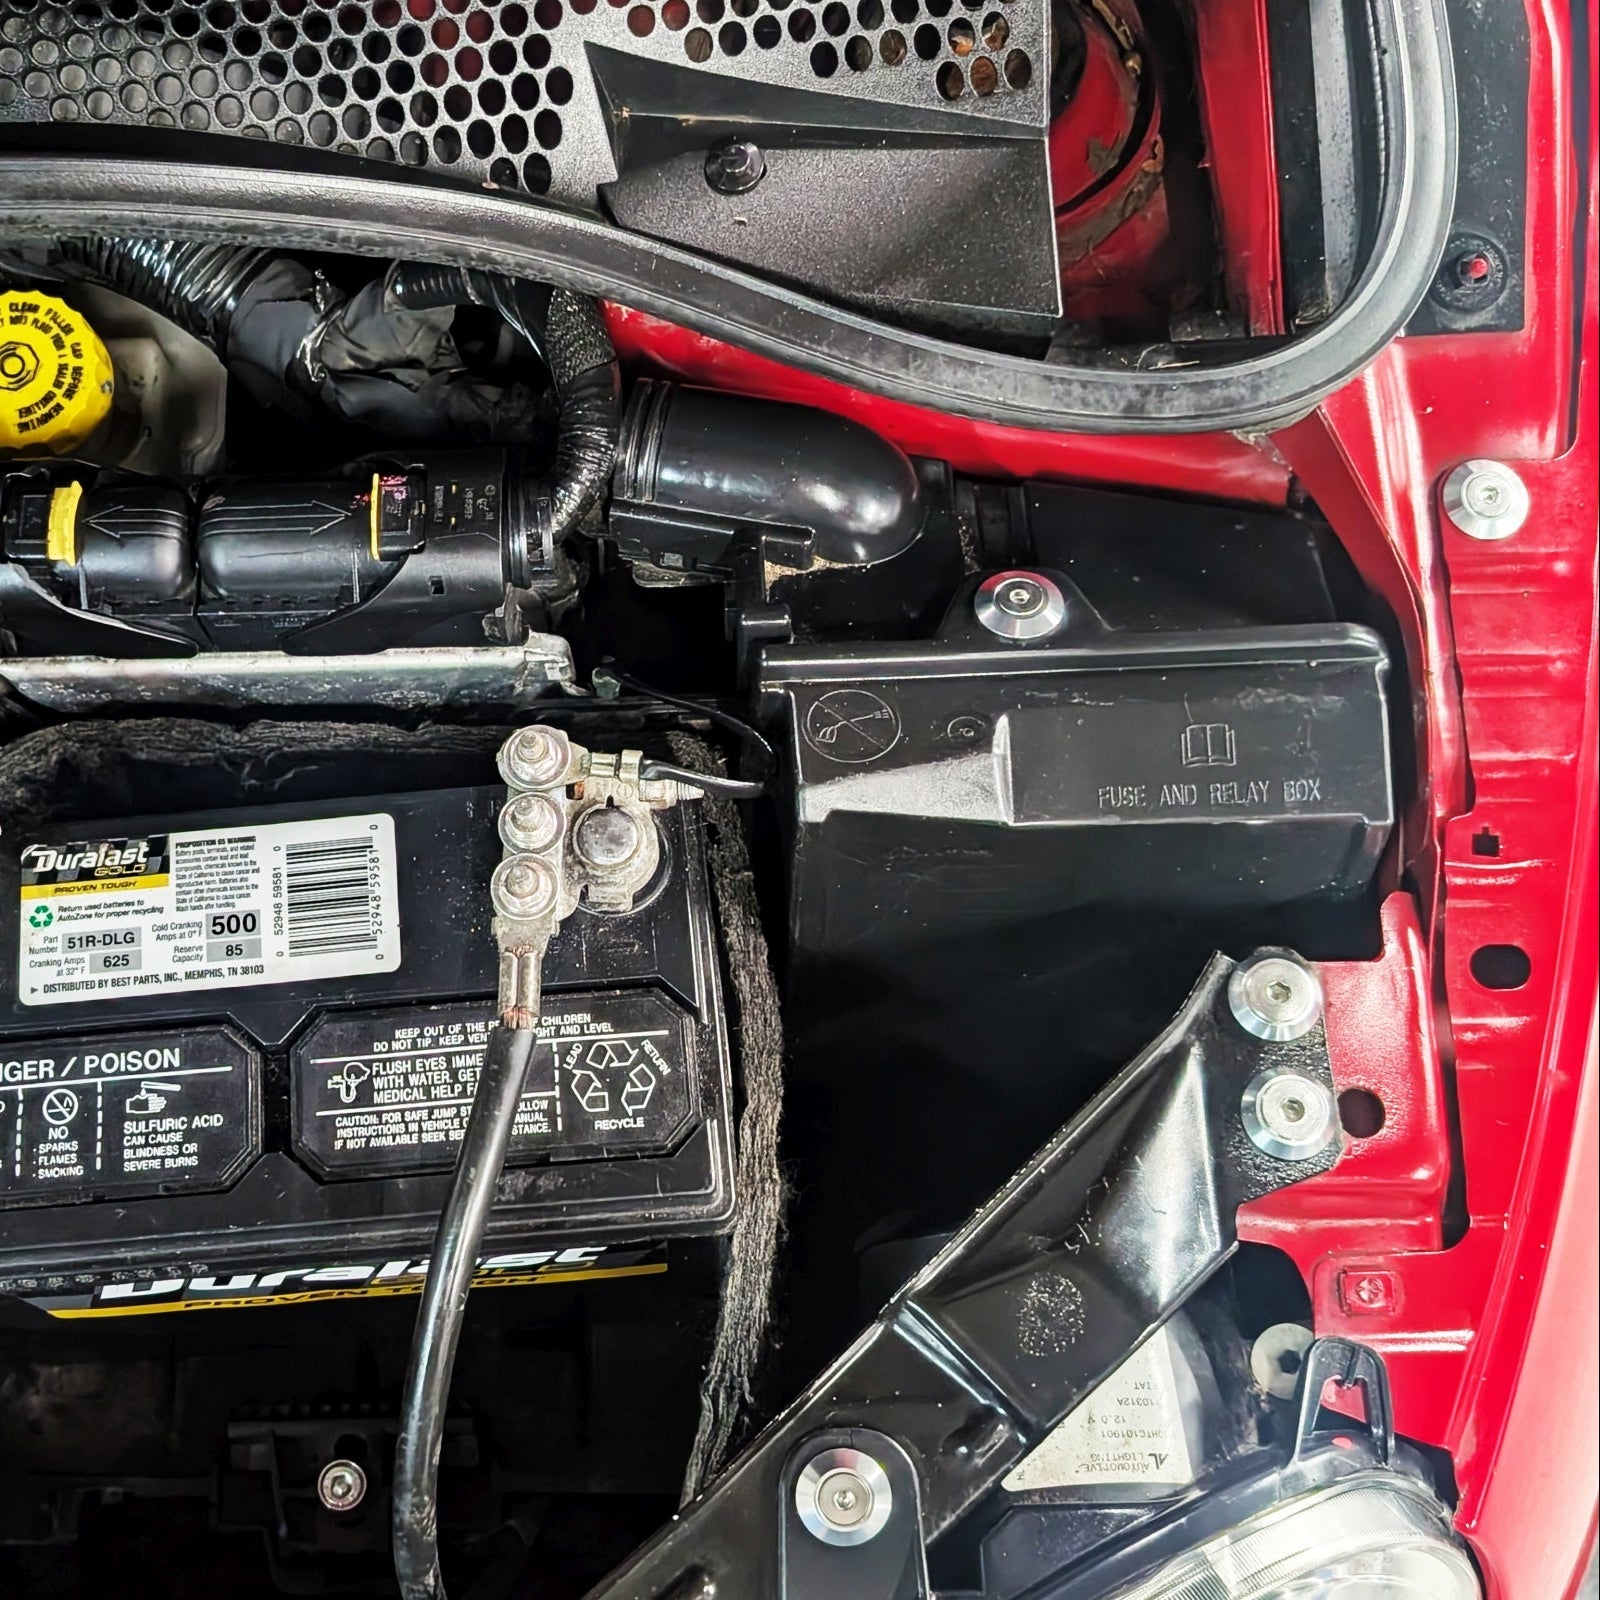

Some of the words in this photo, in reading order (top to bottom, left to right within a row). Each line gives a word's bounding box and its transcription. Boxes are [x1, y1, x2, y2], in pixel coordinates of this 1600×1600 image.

[70, 341, 83, 360] CAP
[1099, 784, 1147, 808] FUSE
[1160, 783, 1198, 806] AND
[1209, 780, 1270, 805] RELAY
[1283, 778, 1322, 801] BOX
[175, 840, 216, 848] PROPOSITION
[227, 835, 256, 844] WARNING
[21, 842, 150, 873] Duralast
[94, 864, 147, 877] GOLD
[369, 850, 381, 888] 59581
[54, 884, 97, 894] PROVEN
[101, 880, 137, 890] TOUGH
[272, 866, 282, 898] 59581
[57, 912, 92, 922] AutoZone
[106, 910, 130, 919] proper
[131, 905, 164, 916] recycling
[58, 905, 82, 913] Return
[85, 903, 101, 911] used
[103, 901, 135, 909] batteries
[370, 895, 382, 935] 52948
[151, 924, 168, 932] Cold
[170, 921, 203, 931] Cranking
[211, 912, 257, 936] 500
[274, 903, 283, 935] 52948
[43, 935, 58, 944] Part
[67, 931, 135, 950] 51R-DLG
[156, 932, 176, 942] Amps
[179, 931, 186, 939] at
[198, 929, 203, 937] F
[29, 945, 58, 955] Number
[174, 945, 203, 953] Reserve
[225, 944, 243, 957] 85
[29, 959, 62, 968] Cranking
[64, 956, 86, 966] Amps
[103, 954, 130, 968] 625
[172, 954, 203, 963] Capacity
[43, 979, 96, 994] DISTRIBUTED
[98, 978, 109, 988] BY
[111, 977, 132, 987] BEST
[133, 974, 162, 985] PARTS,
[185, 967, 225, 981] MEMPHIS,
[227, 966, 238, 977] TN
[240, 964, 264, 975] 38103
[56, 969, 64, 977] at
[80, 966, 86, 975] F
[395, 1028, 420, 1039] KEEP
[424, 1025, 444, 1036] OUT
[448, 1023, 462, 1034] OF
[465, 1021, 485, 1032] THE
[541, 1013, 591, 1025] CHILDREN
[373, 1042, 388, 1053] DO
[391, 1040, 413, 1051] NOT
[439, 1034, 464, 1046] KEEP
[560, 1024, 580, 1035] AND
[584, 1022, 614, 1034] LEVEL
[0, 1059, 55, 1082] GER
[84, 1048, 180, 1075] POISON
[372, 1061, 412, 1076] FLUSH
[415, 1056, 447, 1072] EYES
[452, 1053, 484, 1068] IMME
[563, 1043, 583, 1070] LEAD
[640, 1039, 672, 1076] RETURN
[373, 1075, 404, 1090] WITH
[408, 1070, 453, 1087] WATER.
[458, 1067, 482, 1081] GET
[373, 1087, 427, 1104] MEDICAL
[431, 1083, 463, 1099] HELP
[123, 1116, 188, 1134] SULFURIC
[191, 1113, 224, 1129] ACID
[335, 1114, 379, 1127] CAUTION:
[382, 1112, 402, 1124] FOR
[404, 1109, 429, 1121] SAFE
[431, 1107, 457, 1119] JUMP
[514, 1112, 549, 1125] ANUAL.
[594, 1116, 645, 1131] RECYCLE
[48, 1126, 69, 1140] NO
[337, 1122, 405, 1138] INSTRUCTIONS
[408, 1121, 418, 1132] IN
[421, 1118, 460, 1132] VEHICLE
[511, 1123, 552, 1136] STANCE.
[38, 1140, 78, 1153] SPARKS
[123, 1135, 146, 1146] CAN
[148, 1132, 183, 1144] CAUSE
[334, 1139, 344, 1150] IF
[346, 1137, 367, 1149] NOT
[369, 1133, 418, 1147] AVAILABLE
[421, 1131, 446, 1143] SEEK
[448, 1129, 466, 1141] SER
[123, 1145, 179, 1159] BLINDNESS
[182, 1142, 198, 1154] OR
[38, 1153, 78, 1166] FLAMES
[123, 1159, 161, 1172] SEVERE
[164, 1156, 199, 1168] BURNS
[38, 1165, 84, 1179] SMOKING
[384, 1275, 547, 1295] TOGH
[1083, 1462, 1151, 1473] AUTOMOTIVE
